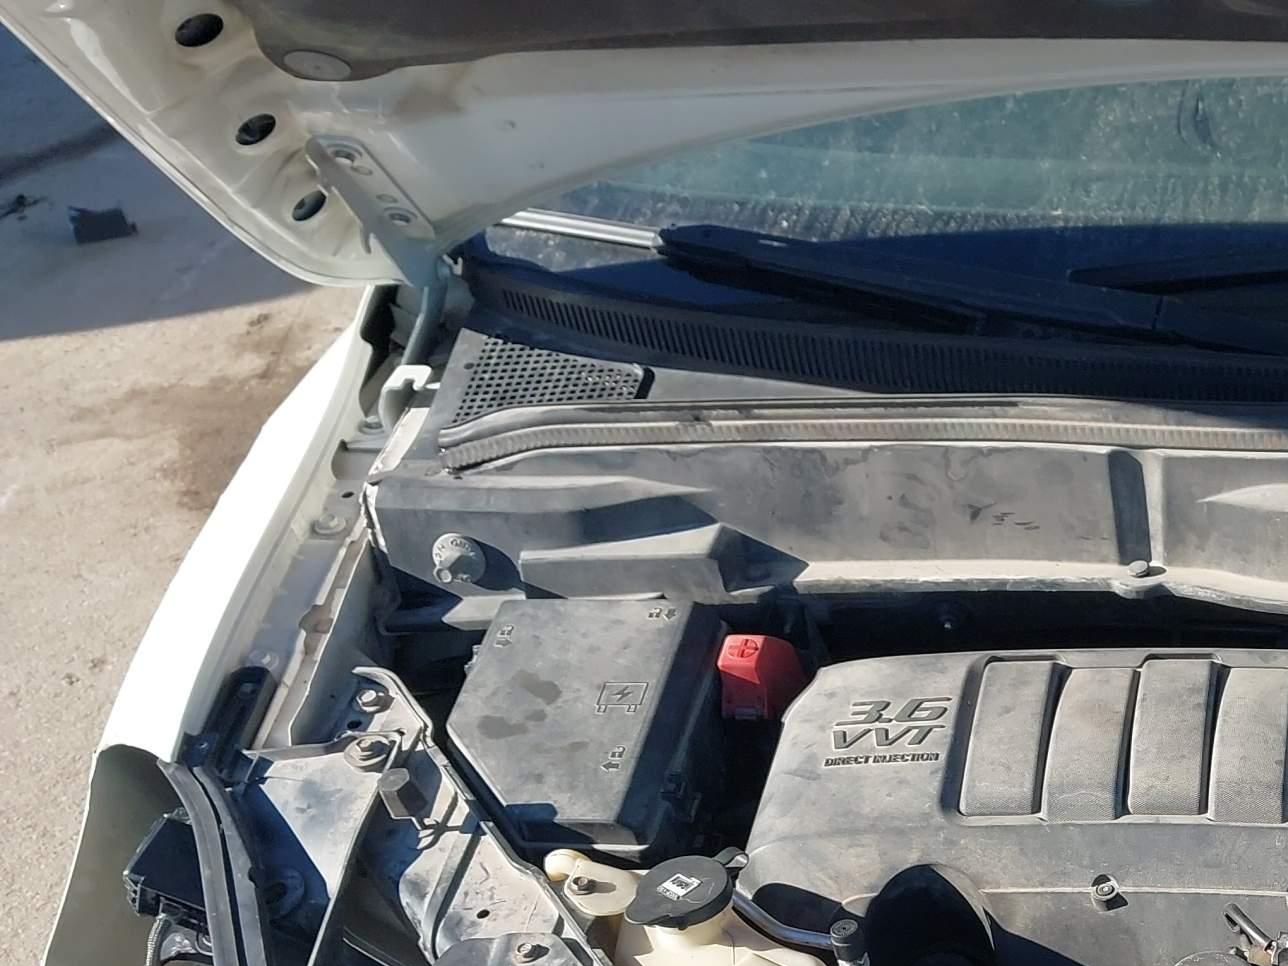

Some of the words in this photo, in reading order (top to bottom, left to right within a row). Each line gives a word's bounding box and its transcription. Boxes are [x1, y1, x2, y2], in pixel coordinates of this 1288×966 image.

[834, 696, 953, 727] 3.6
[833, 724, 946, 750] VVT
[824, 754, 872, 767] DIRECT
[872, 751, 940, 764] INJECTION
